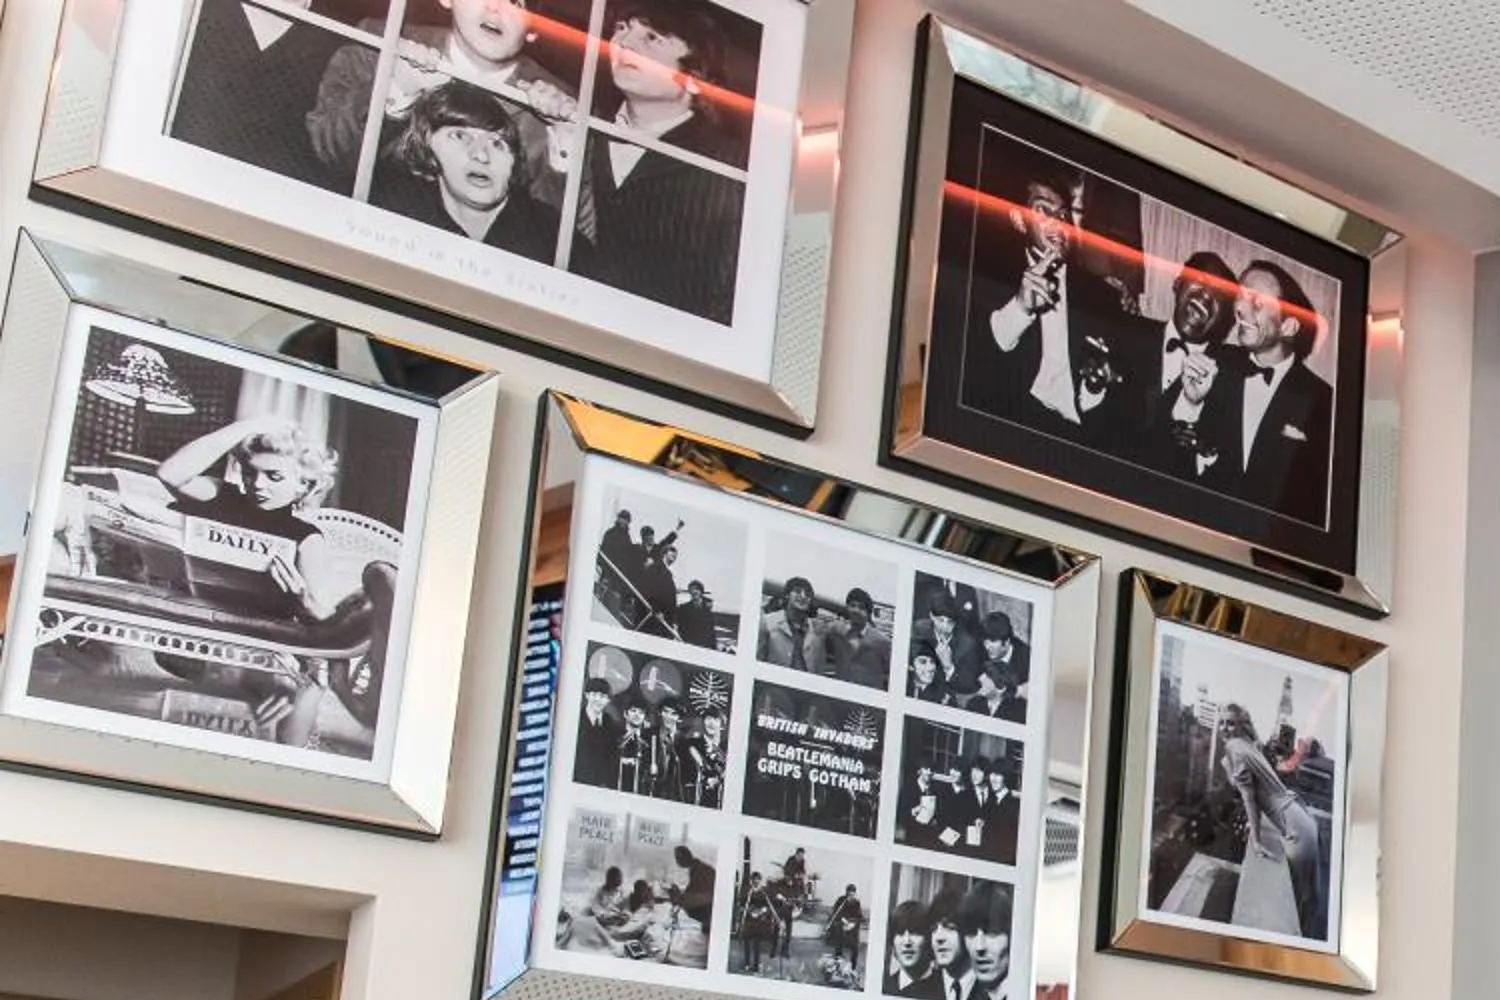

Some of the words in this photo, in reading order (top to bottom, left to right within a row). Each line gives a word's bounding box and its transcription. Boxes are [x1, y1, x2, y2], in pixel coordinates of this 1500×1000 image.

[208, 529, 272, 556] DAILY
[757, 715, 809, 736] BRITISH
[767, 742, 864, 775] BEATLEMANIA
[757, 758, 802, 779] GRIPS
[809, 768, 871, 793] GOTHAM
